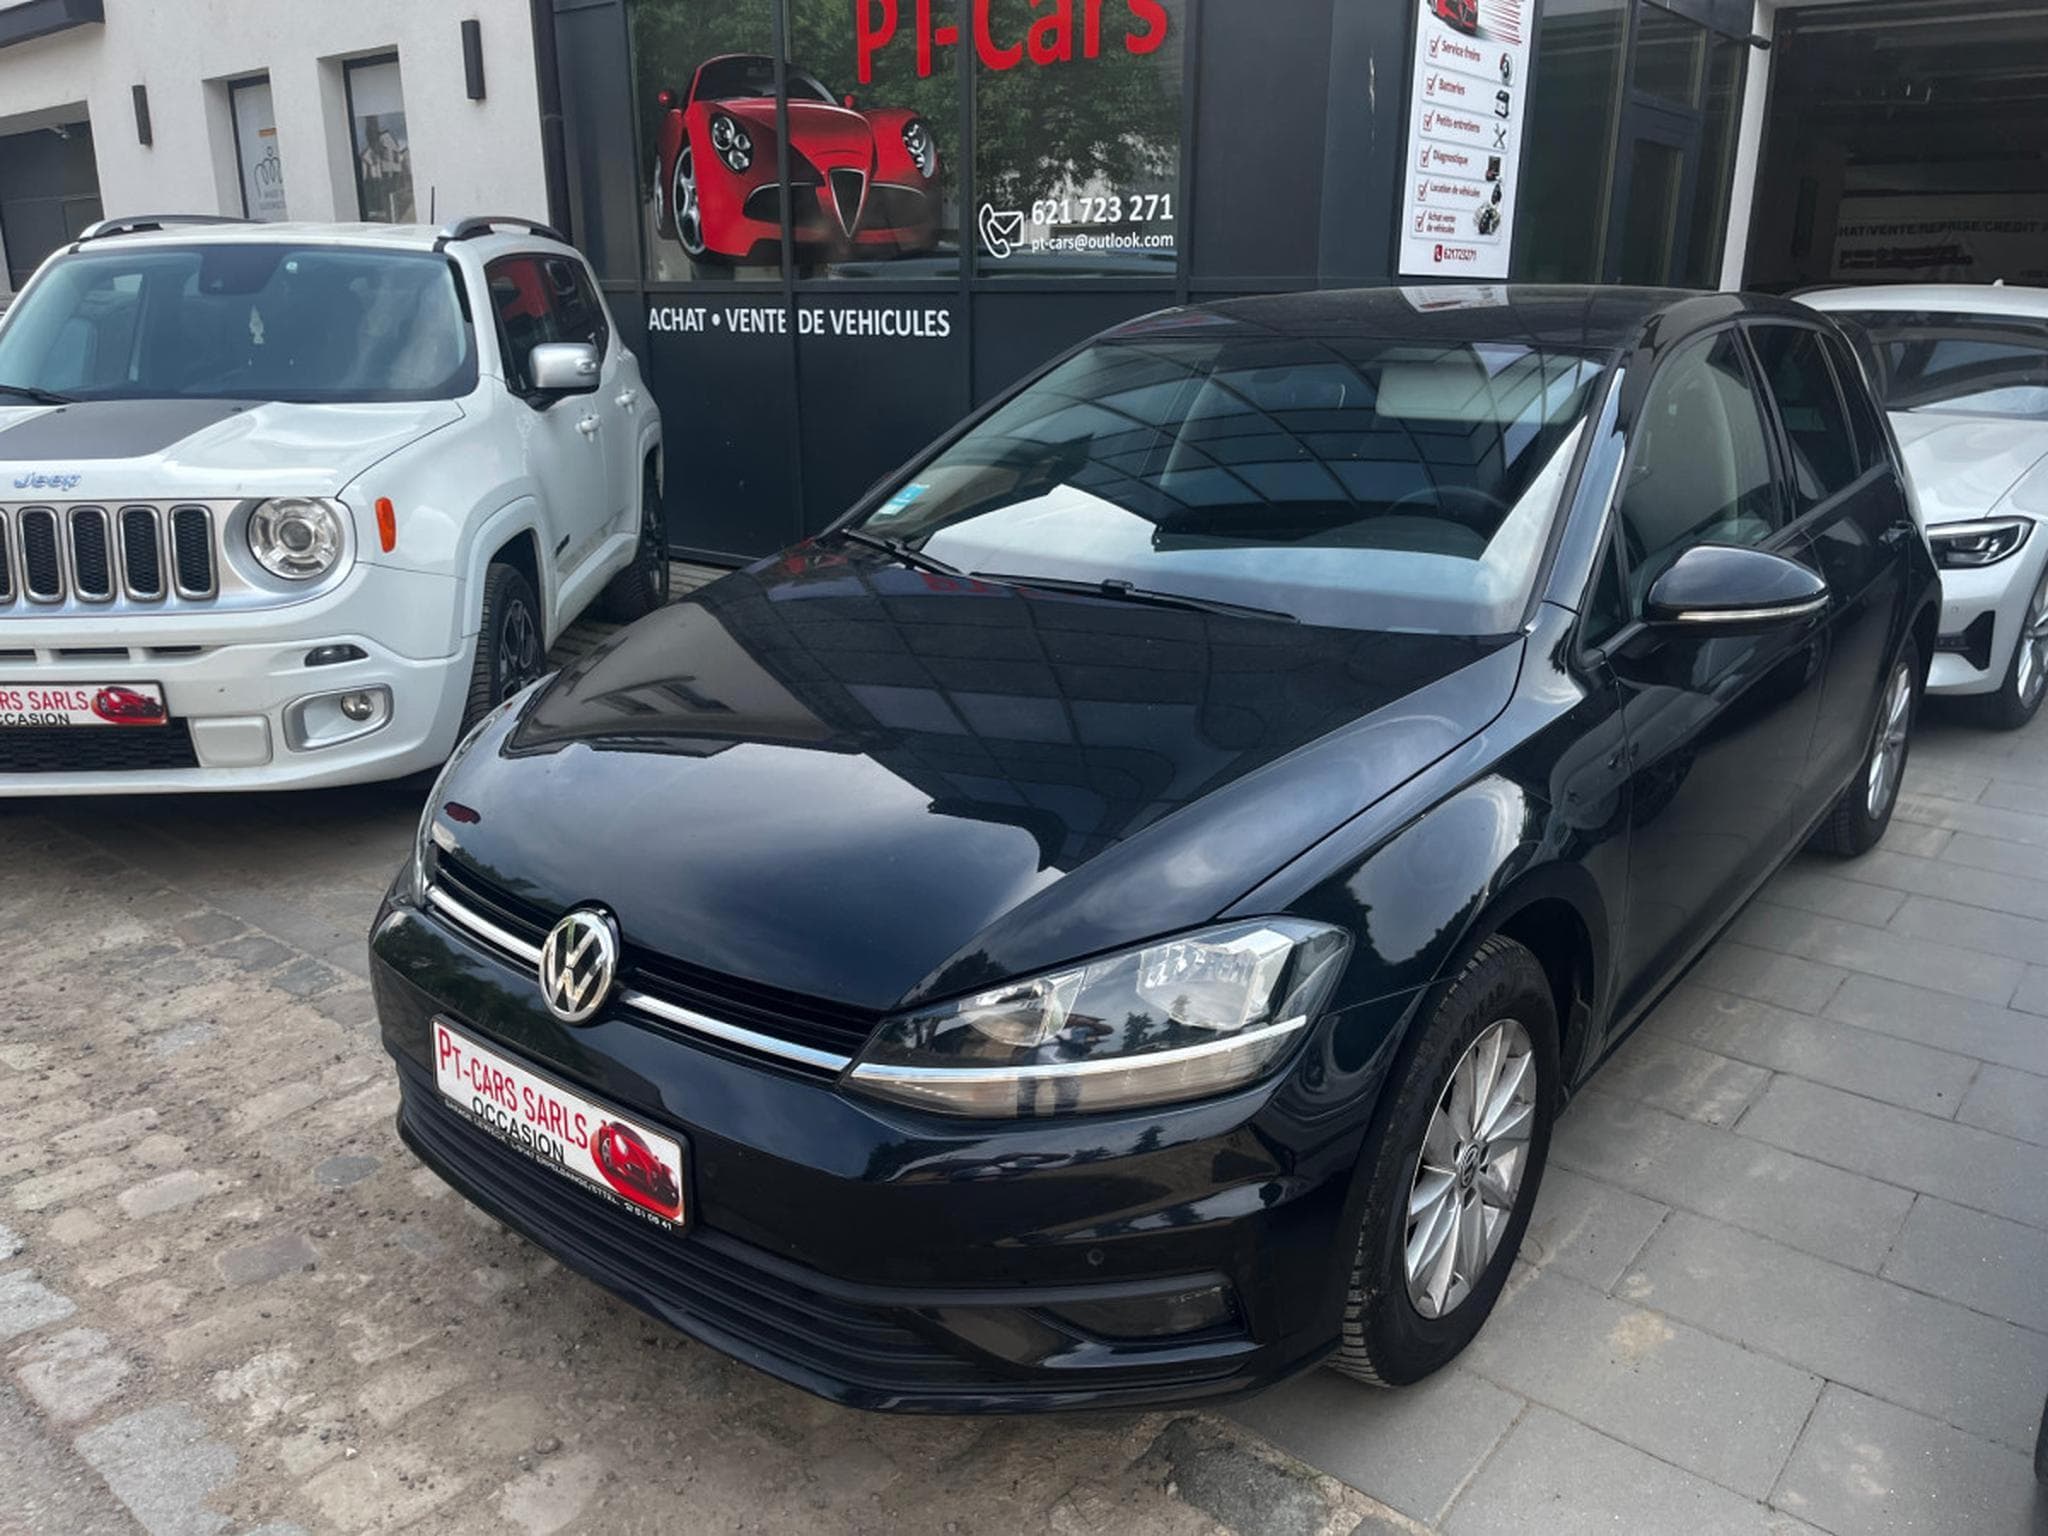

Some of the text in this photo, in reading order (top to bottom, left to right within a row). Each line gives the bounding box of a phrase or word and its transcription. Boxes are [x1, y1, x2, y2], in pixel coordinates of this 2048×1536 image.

[1442, 40, 1463, 57] Service
[1439, 78, 1465, 95] Batteries
[1436, 113, 1480, 133] Petits entretiens
[1433, 149, 1468, 166] Diagnostique
[1430, 184, 1451, 193] Location
[1031, 193, 1174, 225] 621 723 271
[1032, 232, 1174, 253] pt-cars@outlook.com
[649, 308, 951, 337] ACHAT VENTE DE VEHICULES
[14, 472, 81, 492] Jeep
[28, 690, 89, 711] SARLS
[438, 1028, 588, 1150] PT-CARS SARLS
[472, 1096, 565, 1165] OCCASION
